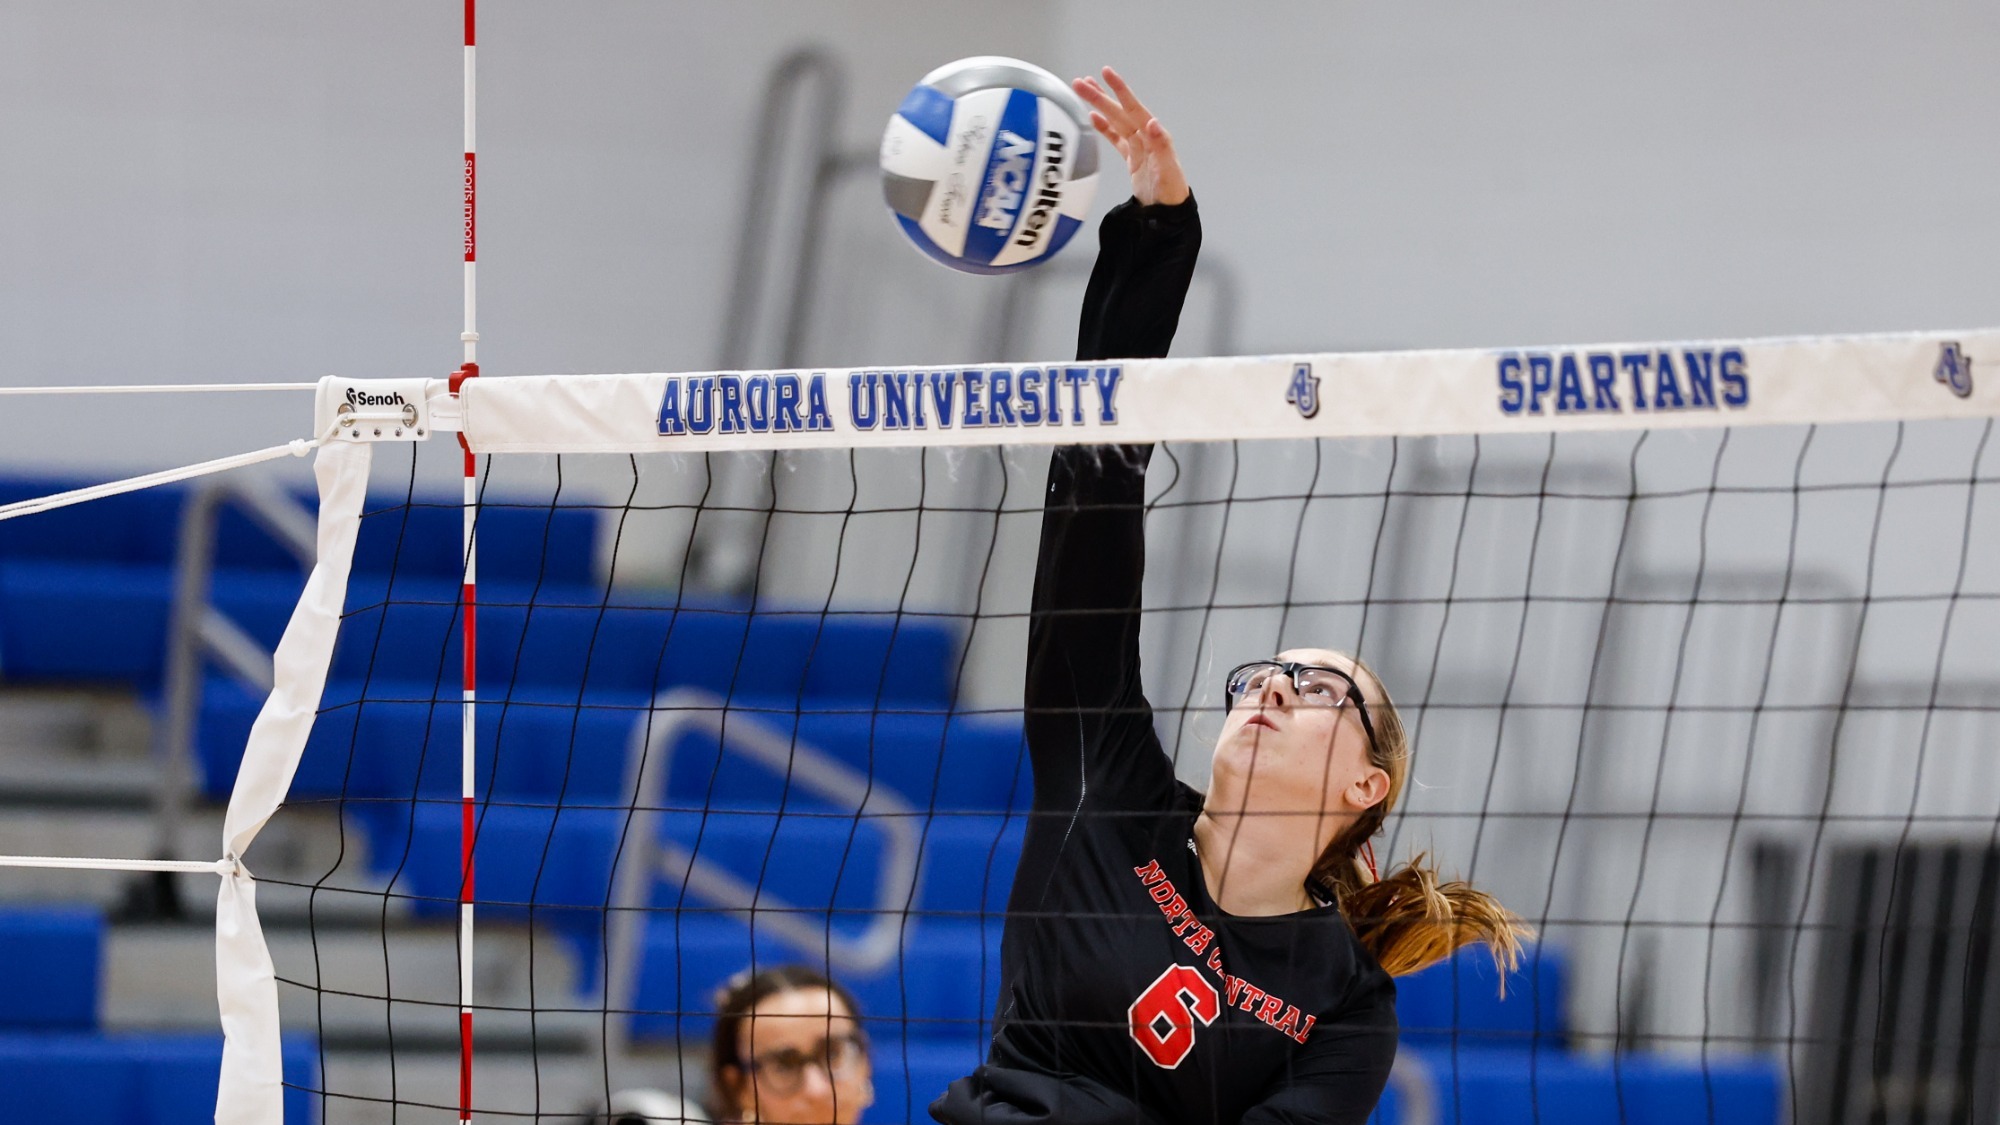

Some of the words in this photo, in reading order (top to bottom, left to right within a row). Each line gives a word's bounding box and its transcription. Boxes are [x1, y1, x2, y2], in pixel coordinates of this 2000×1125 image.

[464, 159, 474, 201] sports
[977, 129, 1036, 231] NCAA
[1015, 130, 1065, 247] molten
[464, 203, 474, 254] imports
[357, 391, 405, 406] Senoh
[656, 372, 835, 436] AURORA
[846, 364, 1124, 431] UNIVERSITY
[1496, 346, 1750, 416] SPARTANS
[1134, 858, 1215, 956] NORTH
[1207, 946, 1318, 1045] CNTRAL
[1127, 962, 1221, 1070] 6
